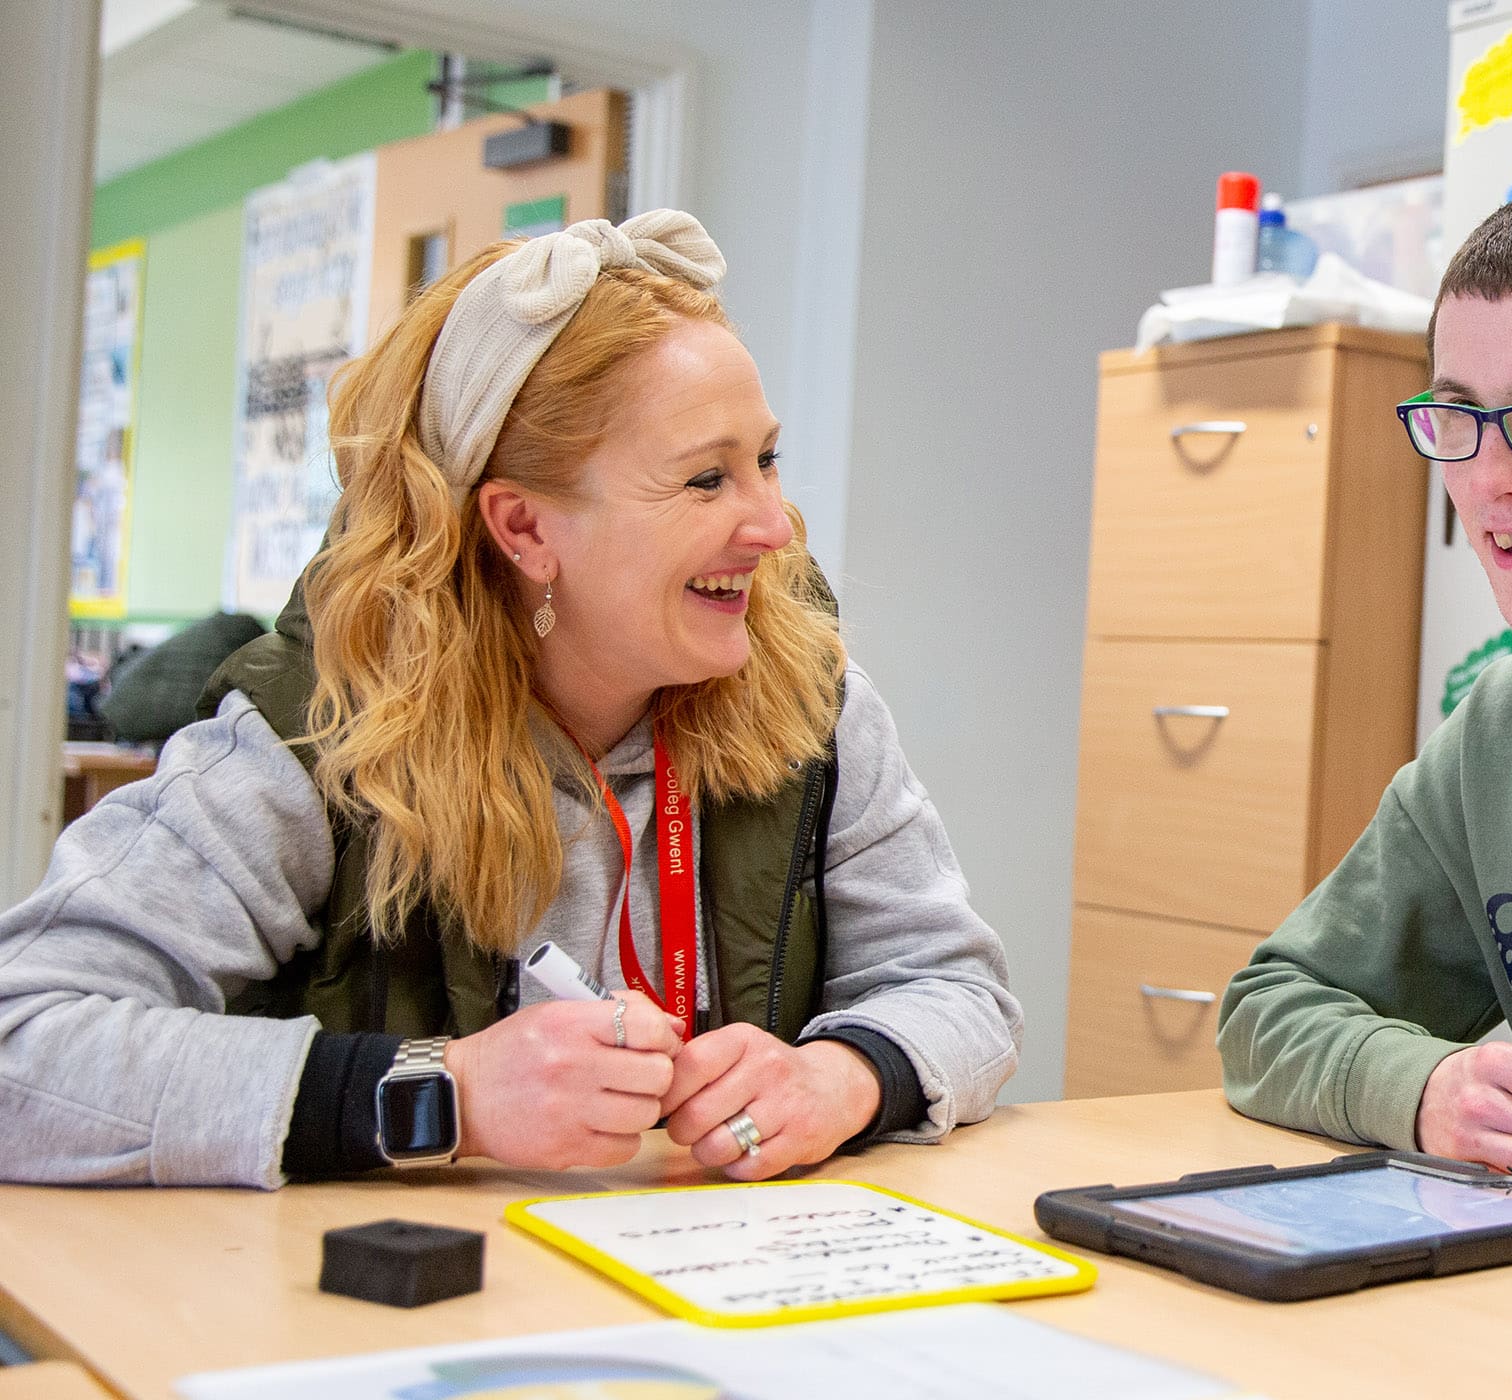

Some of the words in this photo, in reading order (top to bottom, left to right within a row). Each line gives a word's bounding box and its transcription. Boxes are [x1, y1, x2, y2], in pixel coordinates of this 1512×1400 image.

[664, 766, 681, 816] Coleg
[667, 819, 684, 876] Gwent
[673, 948, 688, 1020] www.col
